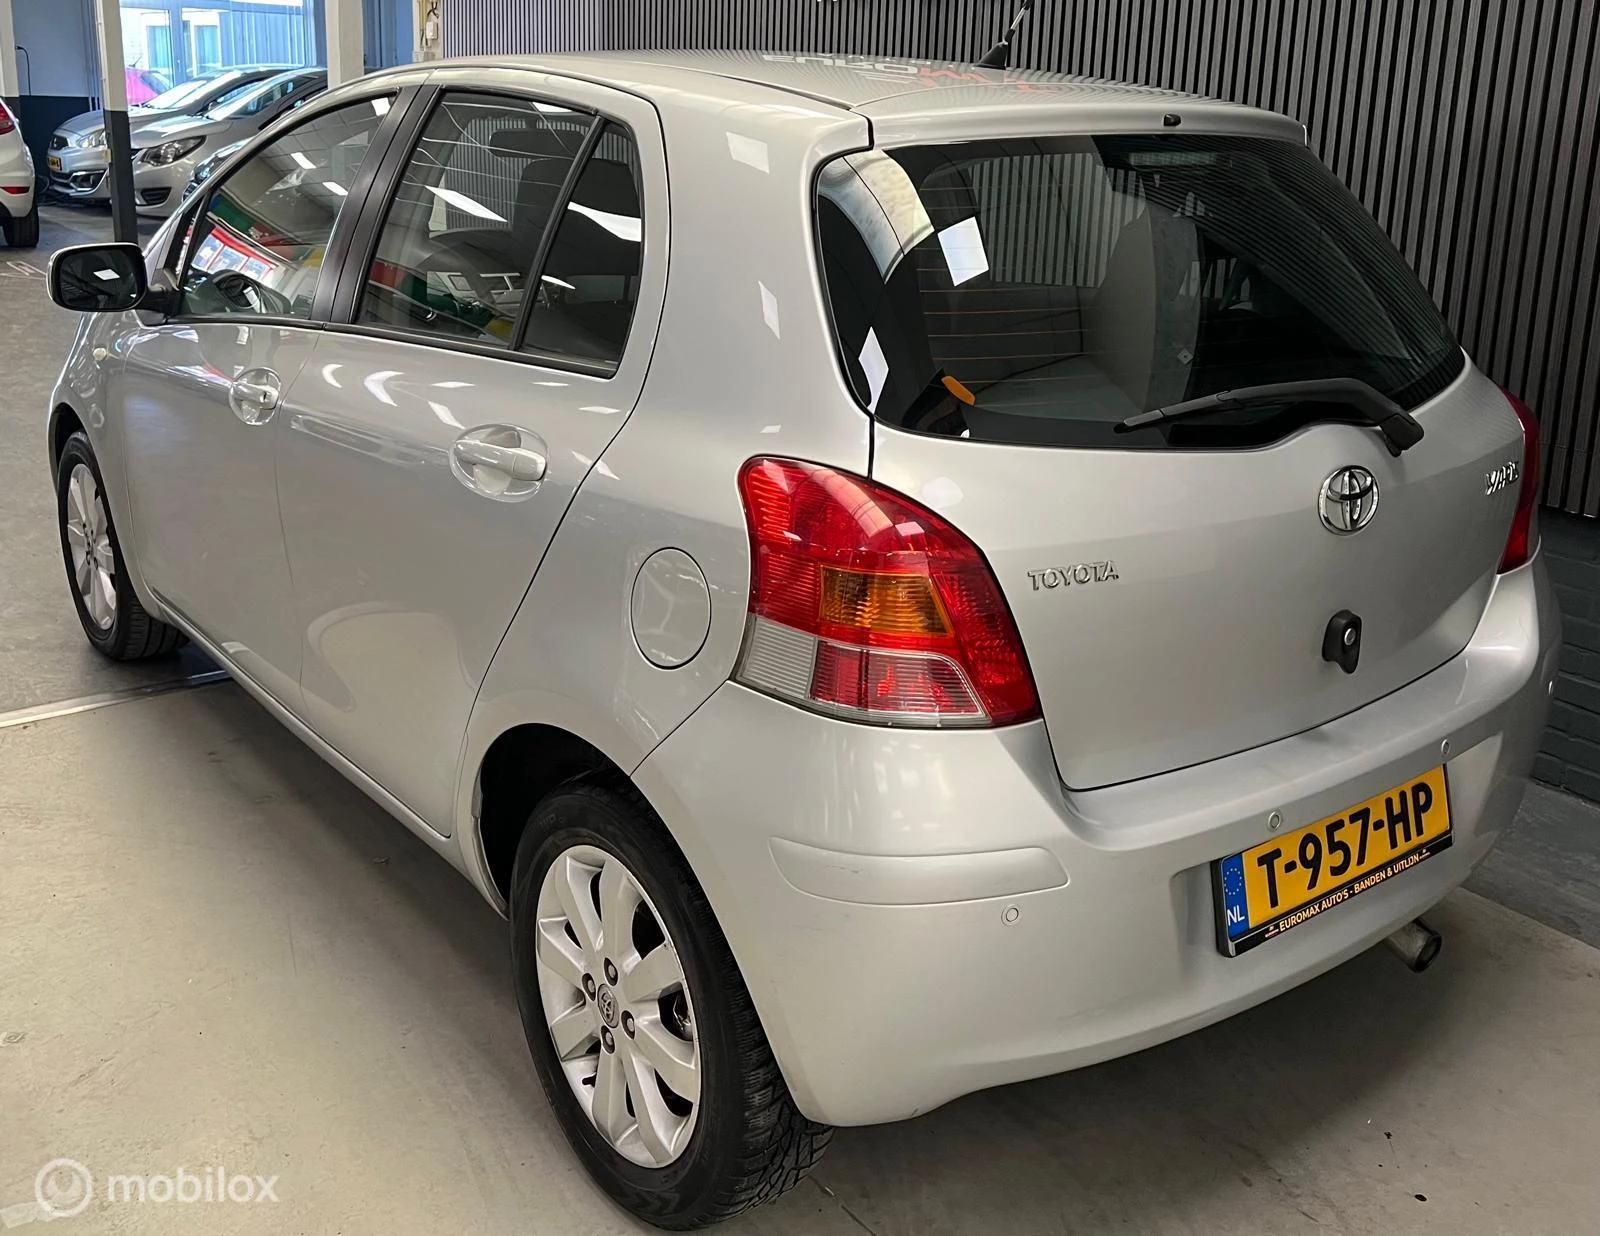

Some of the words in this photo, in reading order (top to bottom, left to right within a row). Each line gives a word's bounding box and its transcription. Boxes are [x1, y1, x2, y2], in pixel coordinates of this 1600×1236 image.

[1027, 560, 1119, 591] TOYOTA
[1257, 781, 1433, 909] T-957-HP
[1226, 904, 1246, 927] NL
[1279, 903, 1320, 932] EUROMAX
[1321, 888, 1349, 911] AUTO'S
[1354, 870, 1386, 894] BANDEN
[1386, 866, 1393, 877] &
